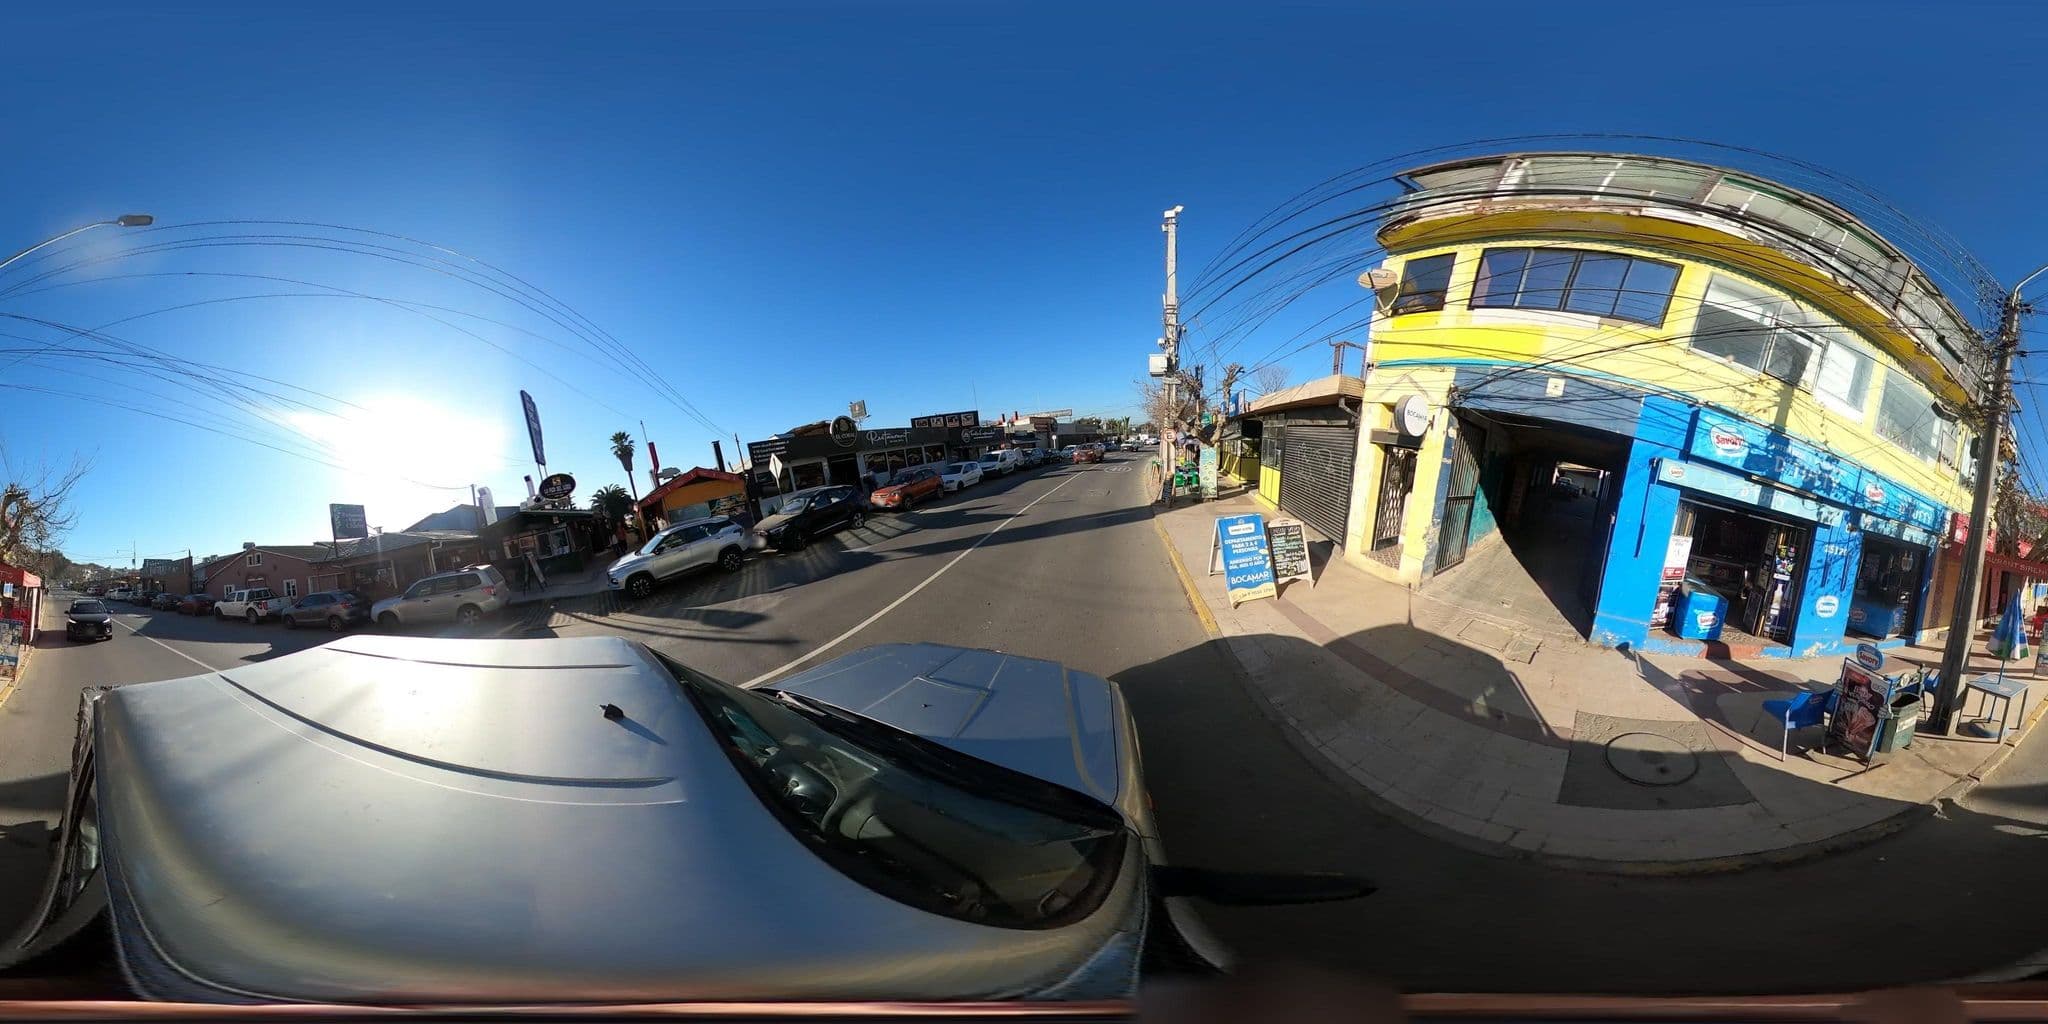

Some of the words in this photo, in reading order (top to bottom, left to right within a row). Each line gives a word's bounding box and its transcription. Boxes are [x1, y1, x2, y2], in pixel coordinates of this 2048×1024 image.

[1407, 410, 1427, 421] BOCAMAR
[1715, 434, 1744, 447] Savory
[1231, 571, 1269, 584] BOCAMAR
[1859, 651, 1879, 666] Savory
